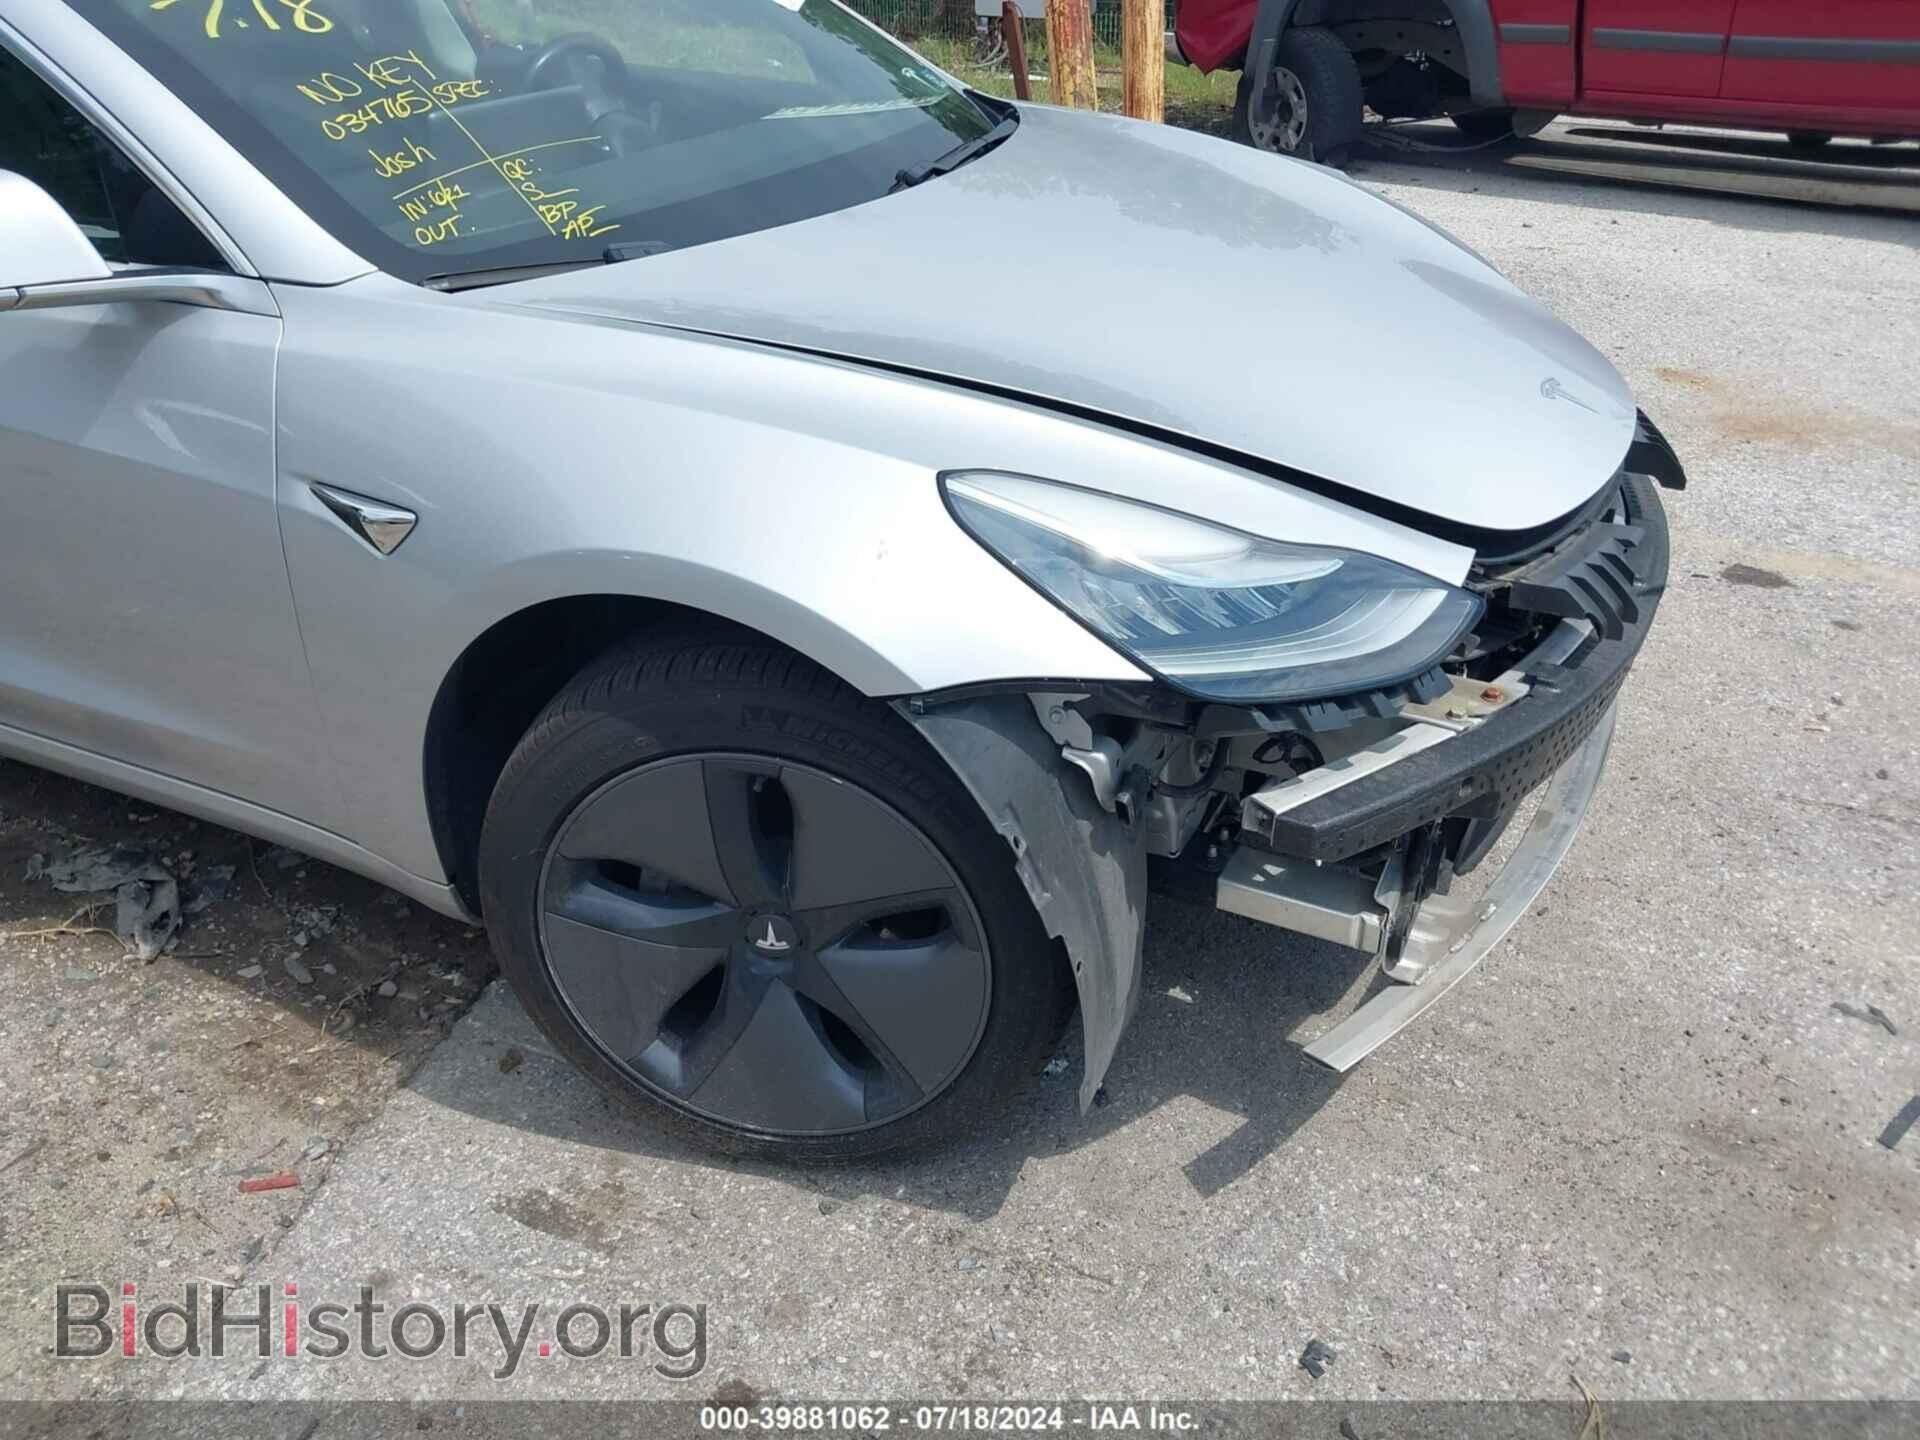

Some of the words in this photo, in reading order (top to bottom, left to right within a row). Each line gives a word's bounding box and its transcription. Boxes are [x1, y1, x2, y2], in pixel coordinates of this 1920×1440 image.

[296, 72, 362, 105] NO
[352, 49, 436, 89] KEY
[367, 136, 437, 178] Josh
